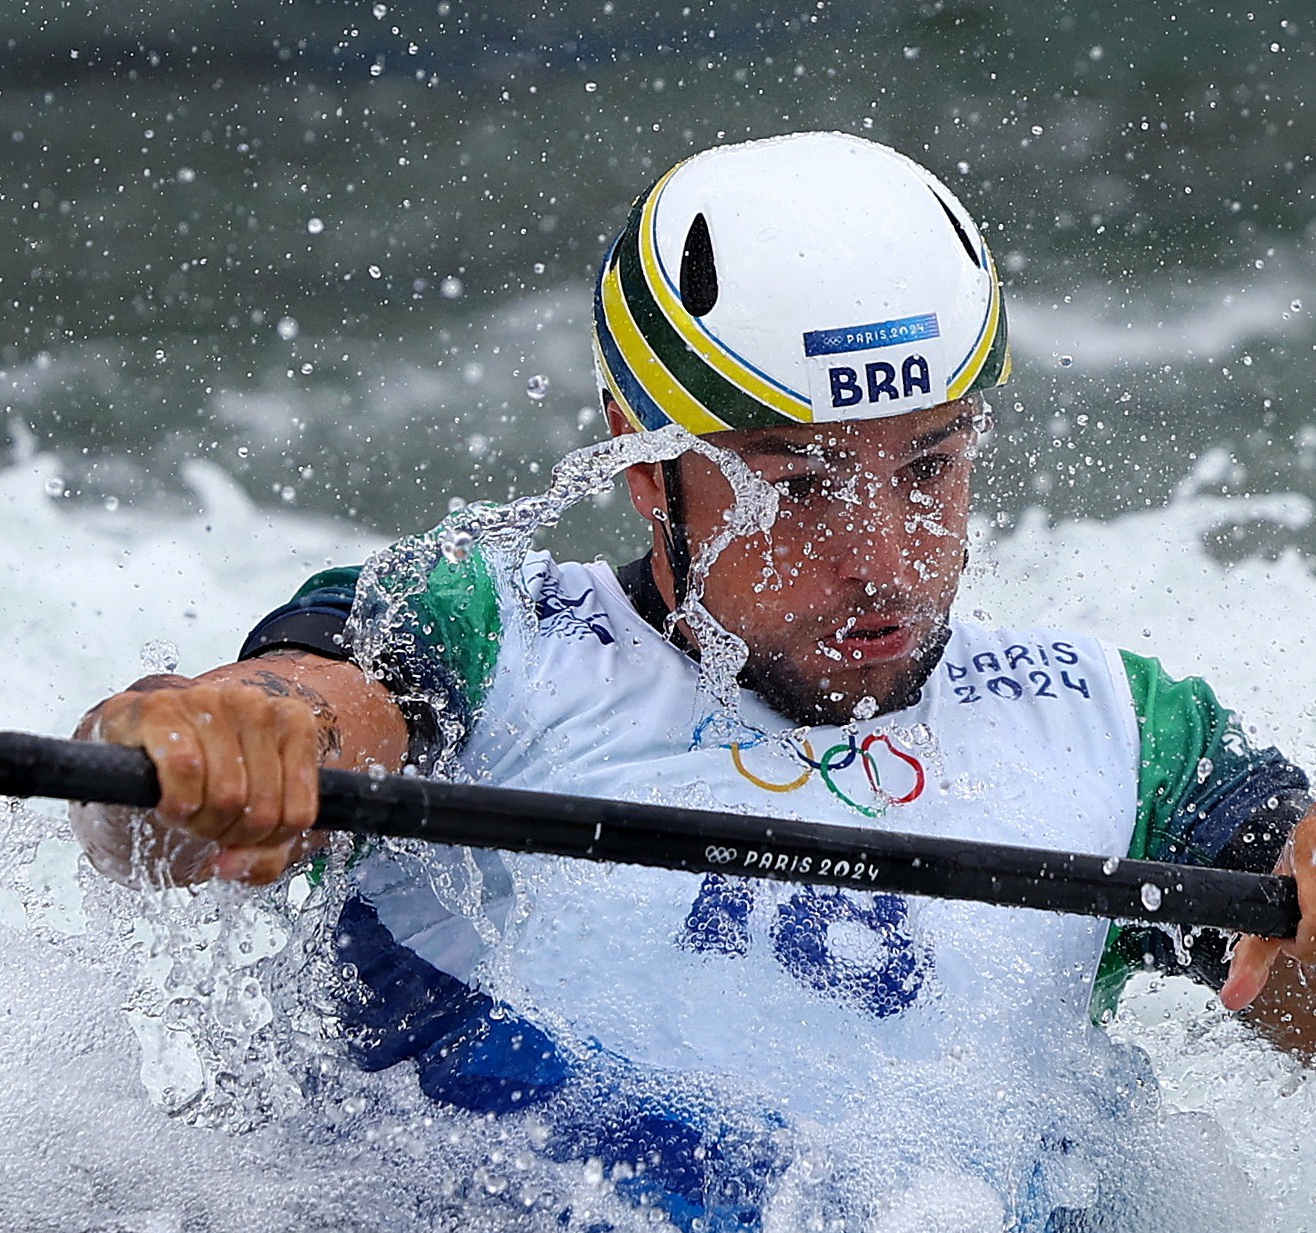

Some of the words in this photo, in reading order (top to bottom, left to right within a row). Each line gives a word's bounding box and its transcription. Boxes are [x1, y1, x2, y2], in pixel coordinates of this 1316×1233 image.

[846, 329, 887, 344] PARIS
[890, 323, 926, 338] 2024
[828, 354, 931, 408] BRA
[945, 641, 1079, 682] PARIS
[953, 670, 1091, 704] 2024
[743, 850, 813, 873] PARIS
[818, 858, 879, 882] 2024
